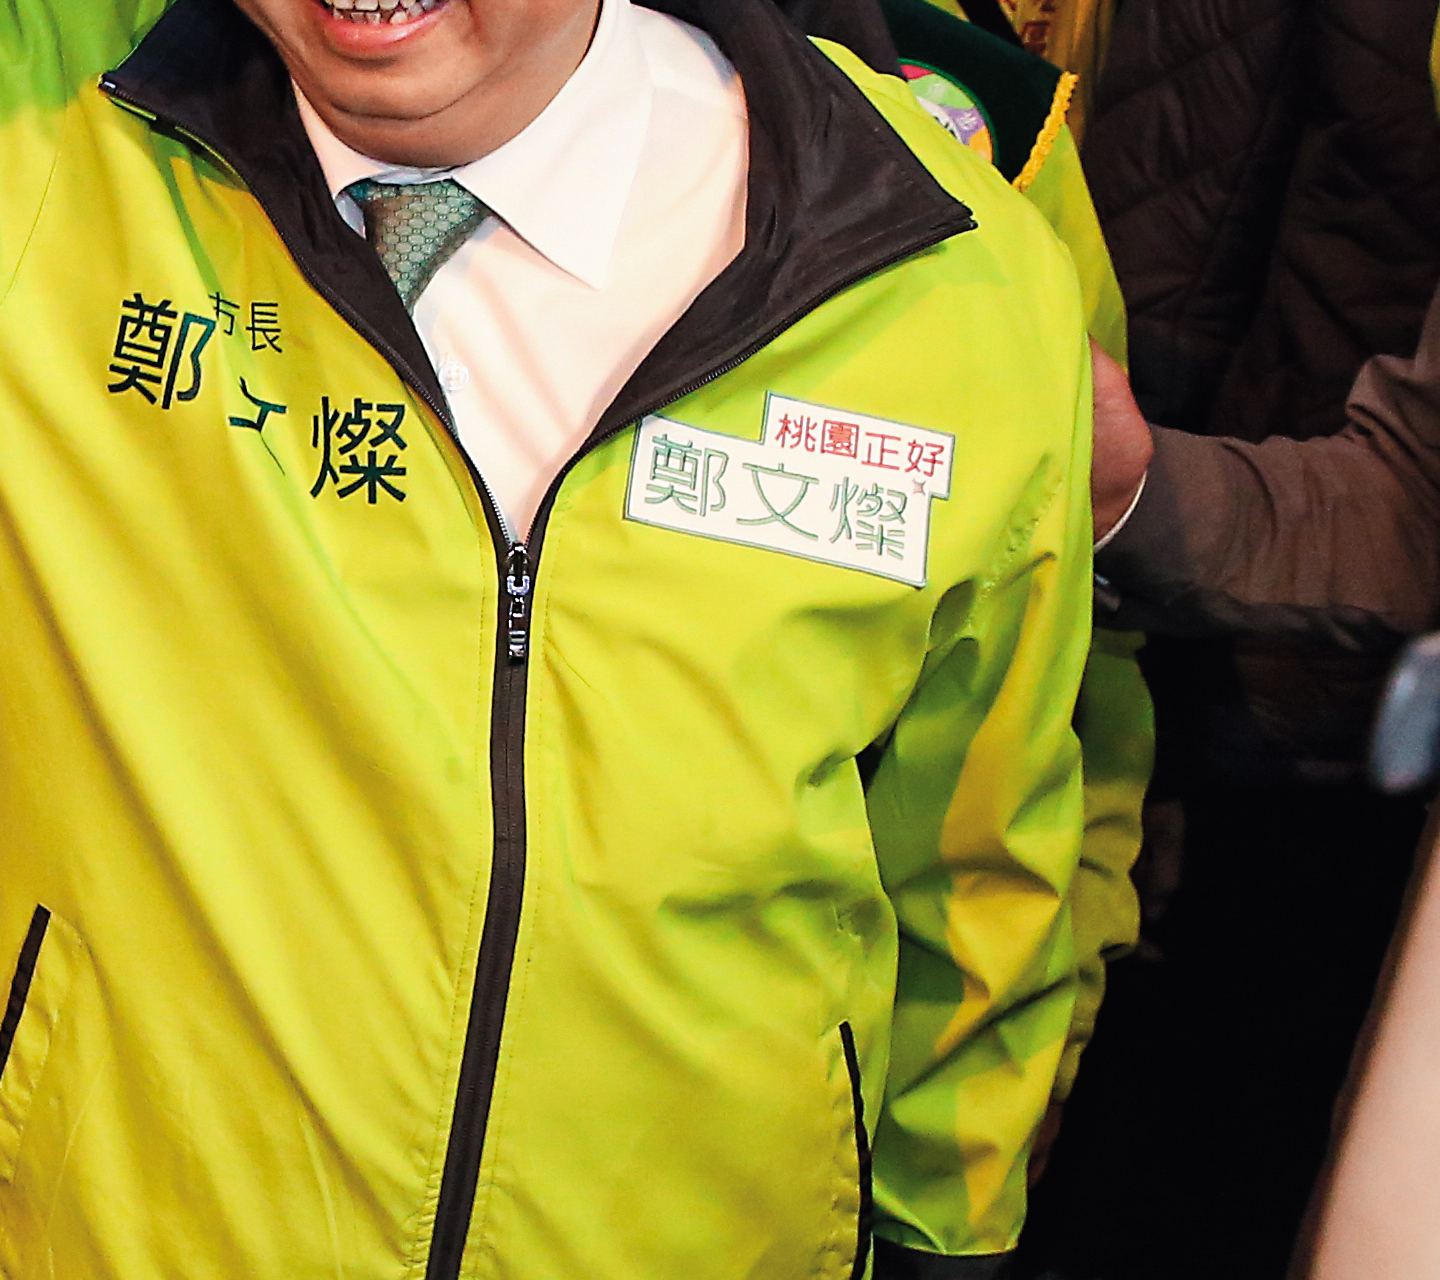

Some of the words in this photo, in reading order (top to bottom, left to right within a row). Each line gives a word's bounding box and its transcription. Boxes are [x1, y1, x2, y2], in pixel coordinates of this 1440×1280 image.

[774, 413, 946, 478] 桃園正好
[643, 433, 909, 560] 鄭文燦
